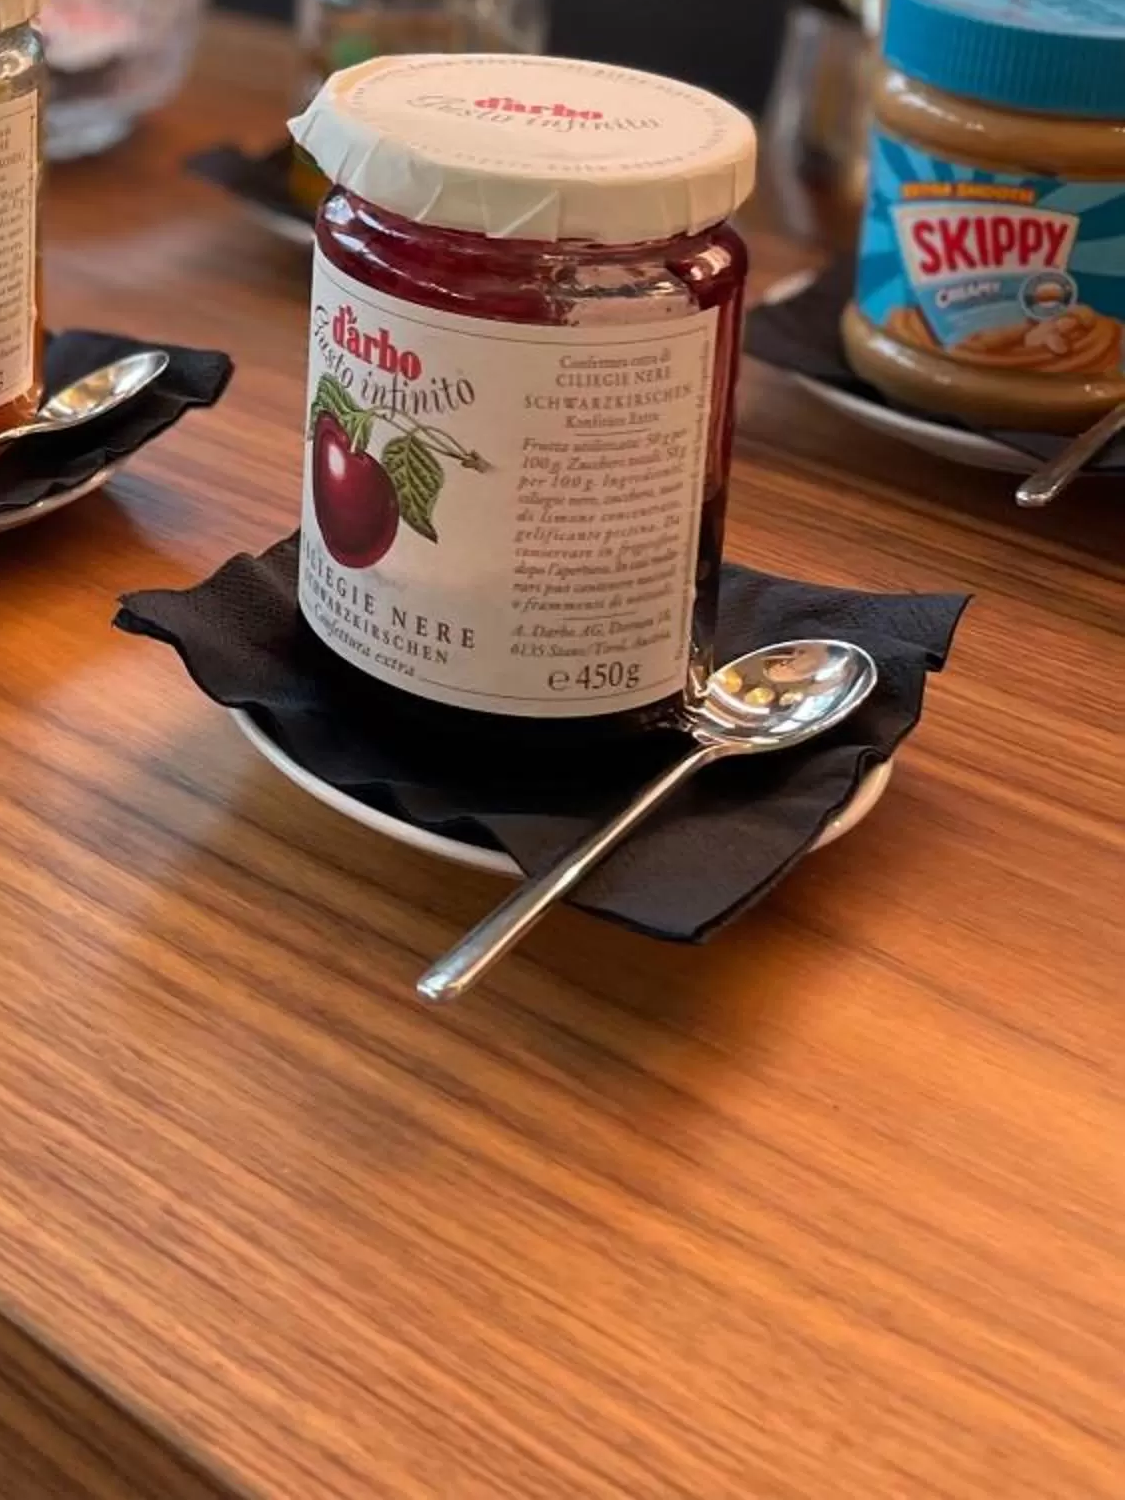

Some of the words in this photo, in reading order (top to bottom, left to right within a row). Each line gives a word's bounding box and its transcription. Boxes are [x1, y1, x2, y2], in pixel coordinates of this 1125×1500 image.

[912, 216, 1069, 277] SKIPPY
[360, 369, 475, 419] infinito
[391, 605, 476, 650] NERE
